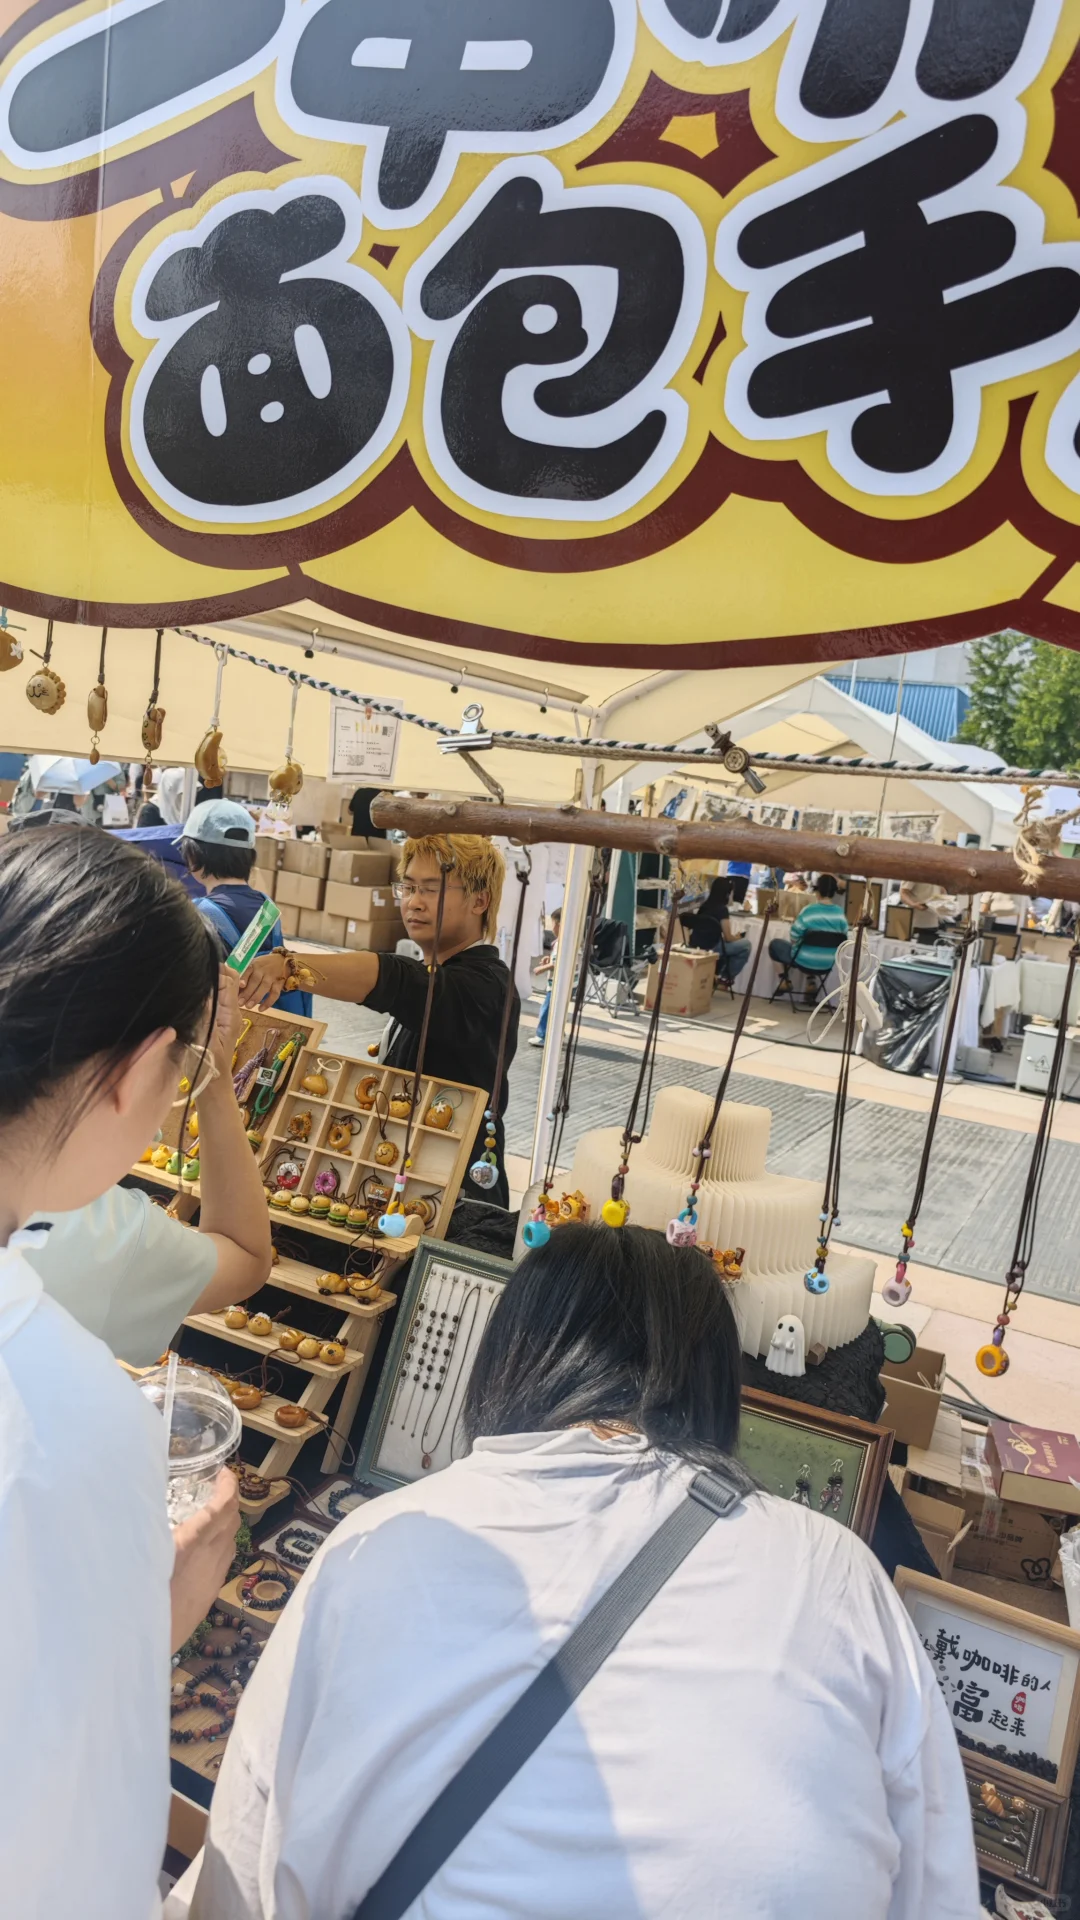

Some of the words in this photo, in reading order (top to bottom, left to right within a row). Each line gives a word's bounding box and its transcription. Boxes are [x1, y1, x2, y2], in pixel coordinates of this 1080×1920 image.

[142, 113, 1080, 507] 面包手
[920, 1628, 1051, 1693] 戴咖啡的人
[936, 1679, 1027, 1737] 富起来
